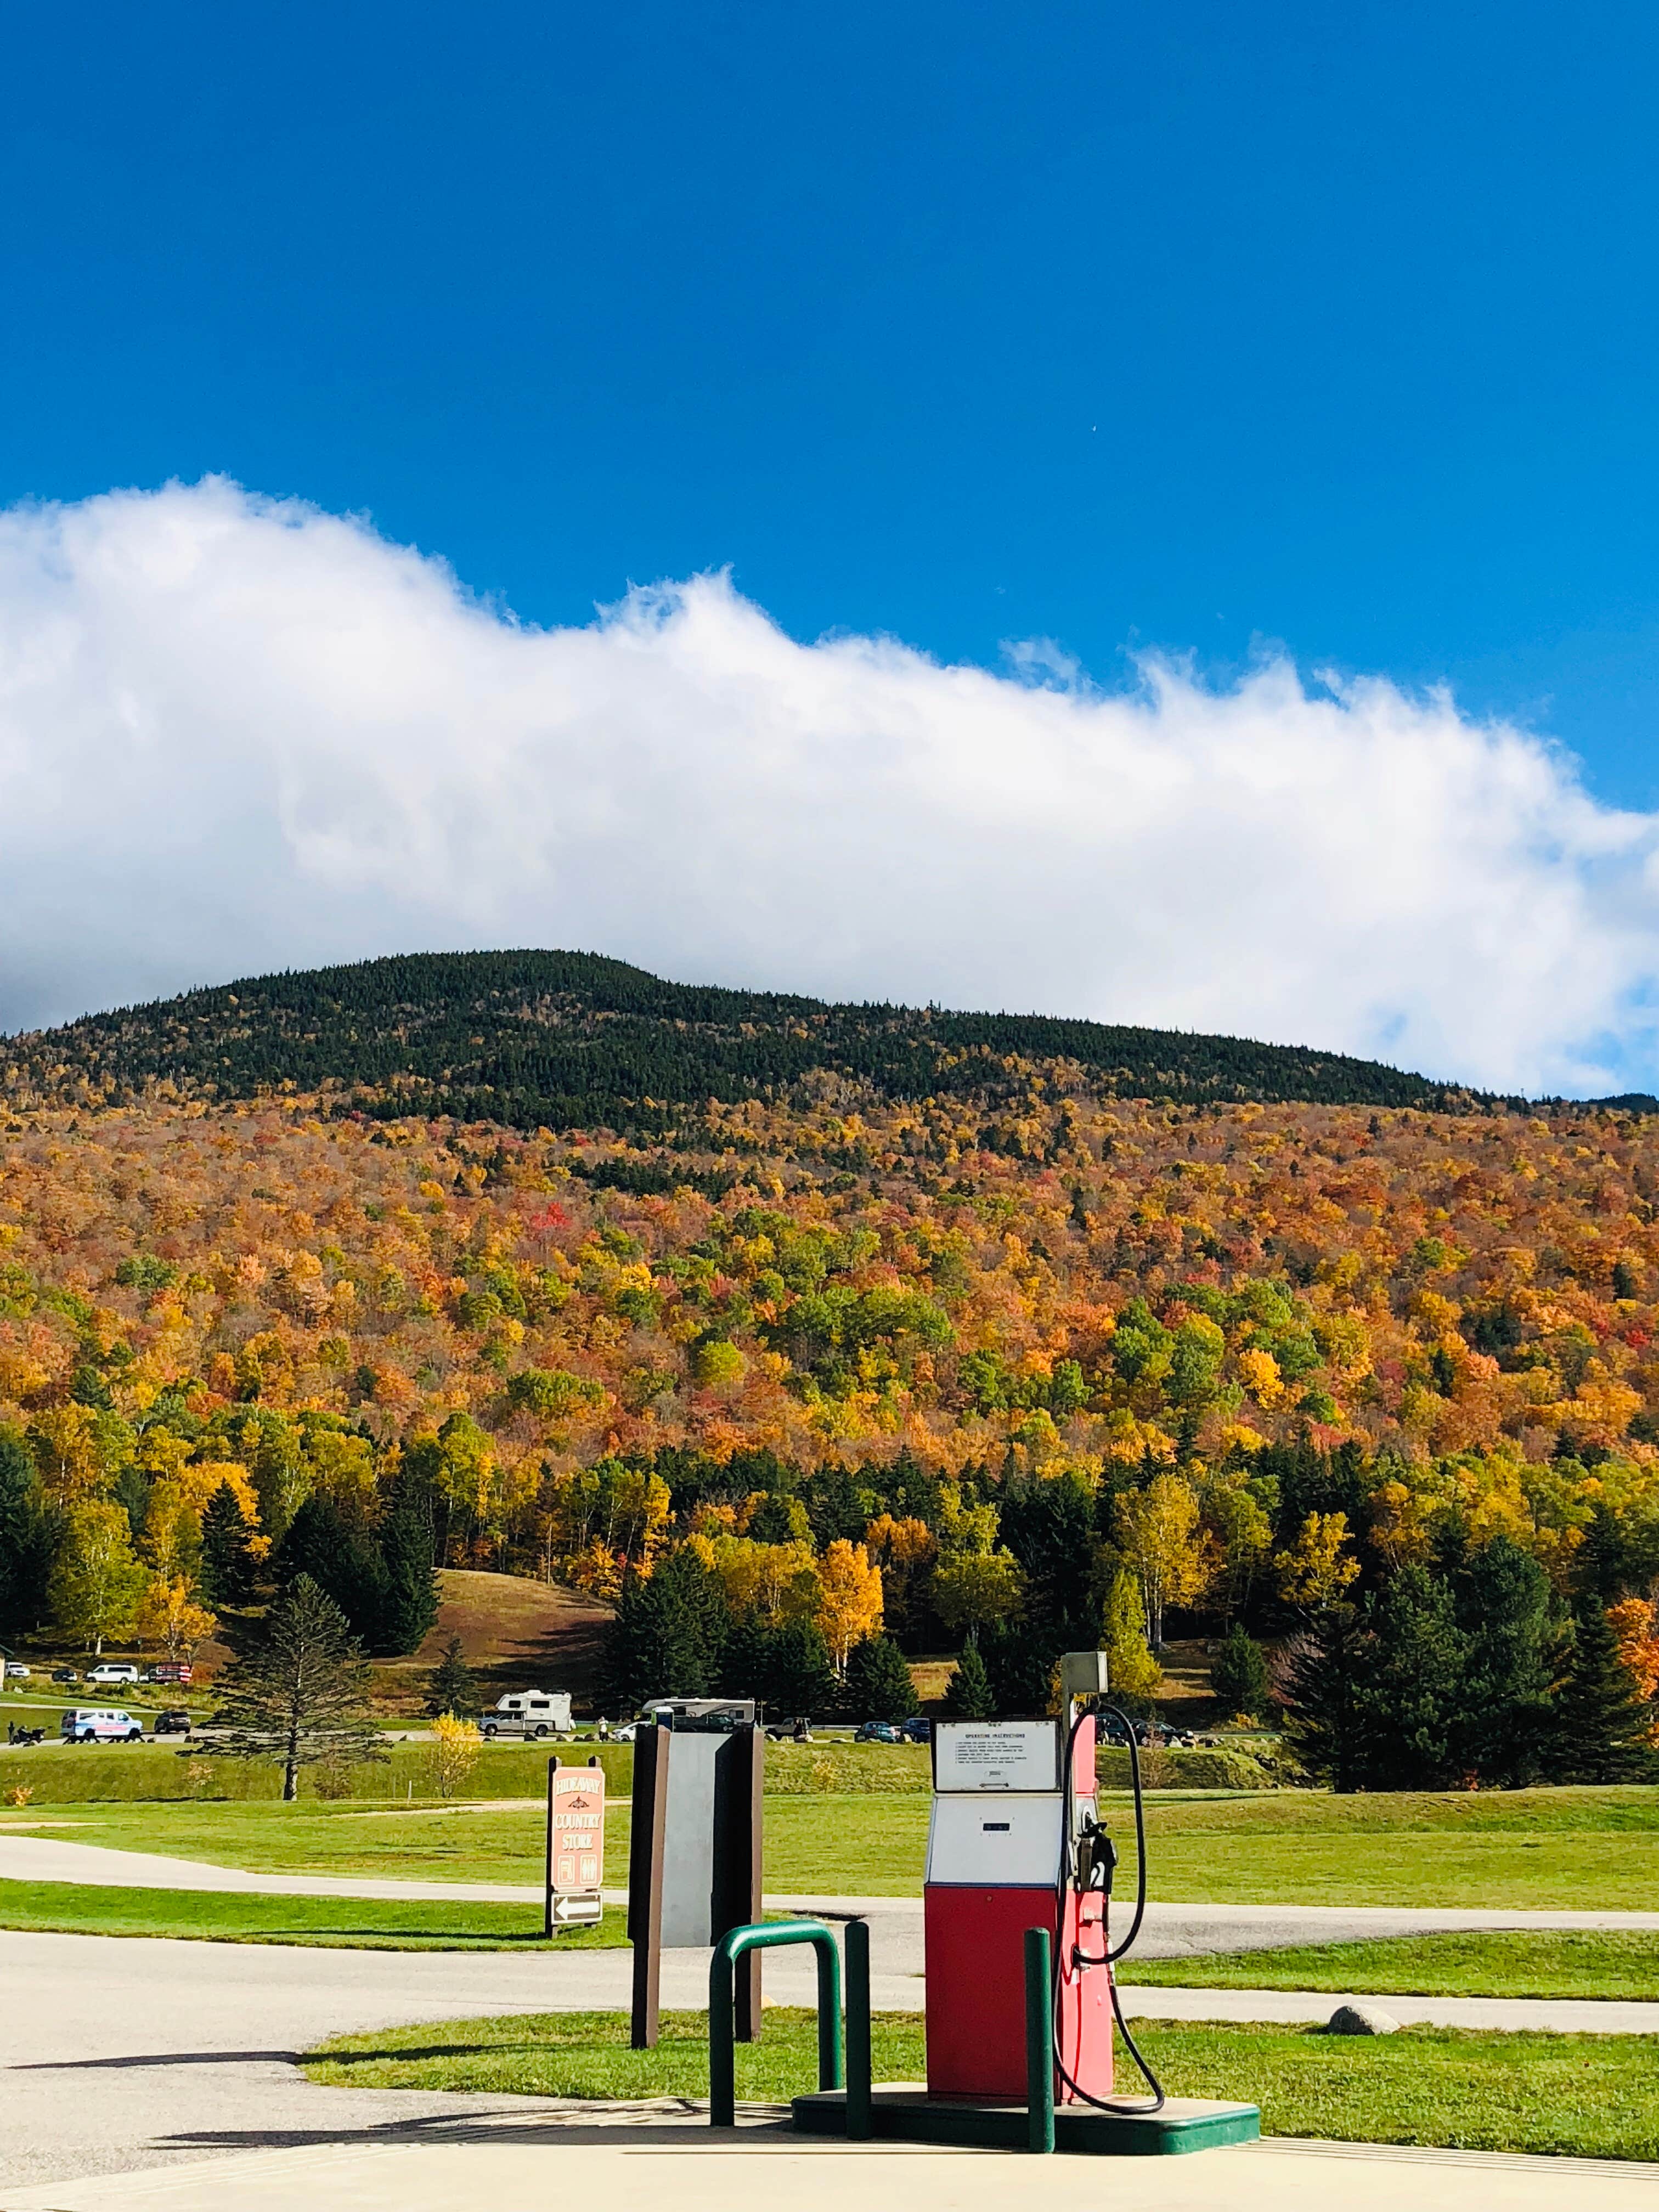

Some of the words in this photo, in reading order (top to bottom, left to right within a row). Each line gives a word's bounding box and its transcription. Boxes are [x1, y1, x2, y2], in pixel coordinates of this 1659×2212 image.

[556, 1776, 601, 1796] HIDEAWAY
[555, 1813, 601, 1830] COUNTRY
[562, 1833, 593, 1850] STORE
